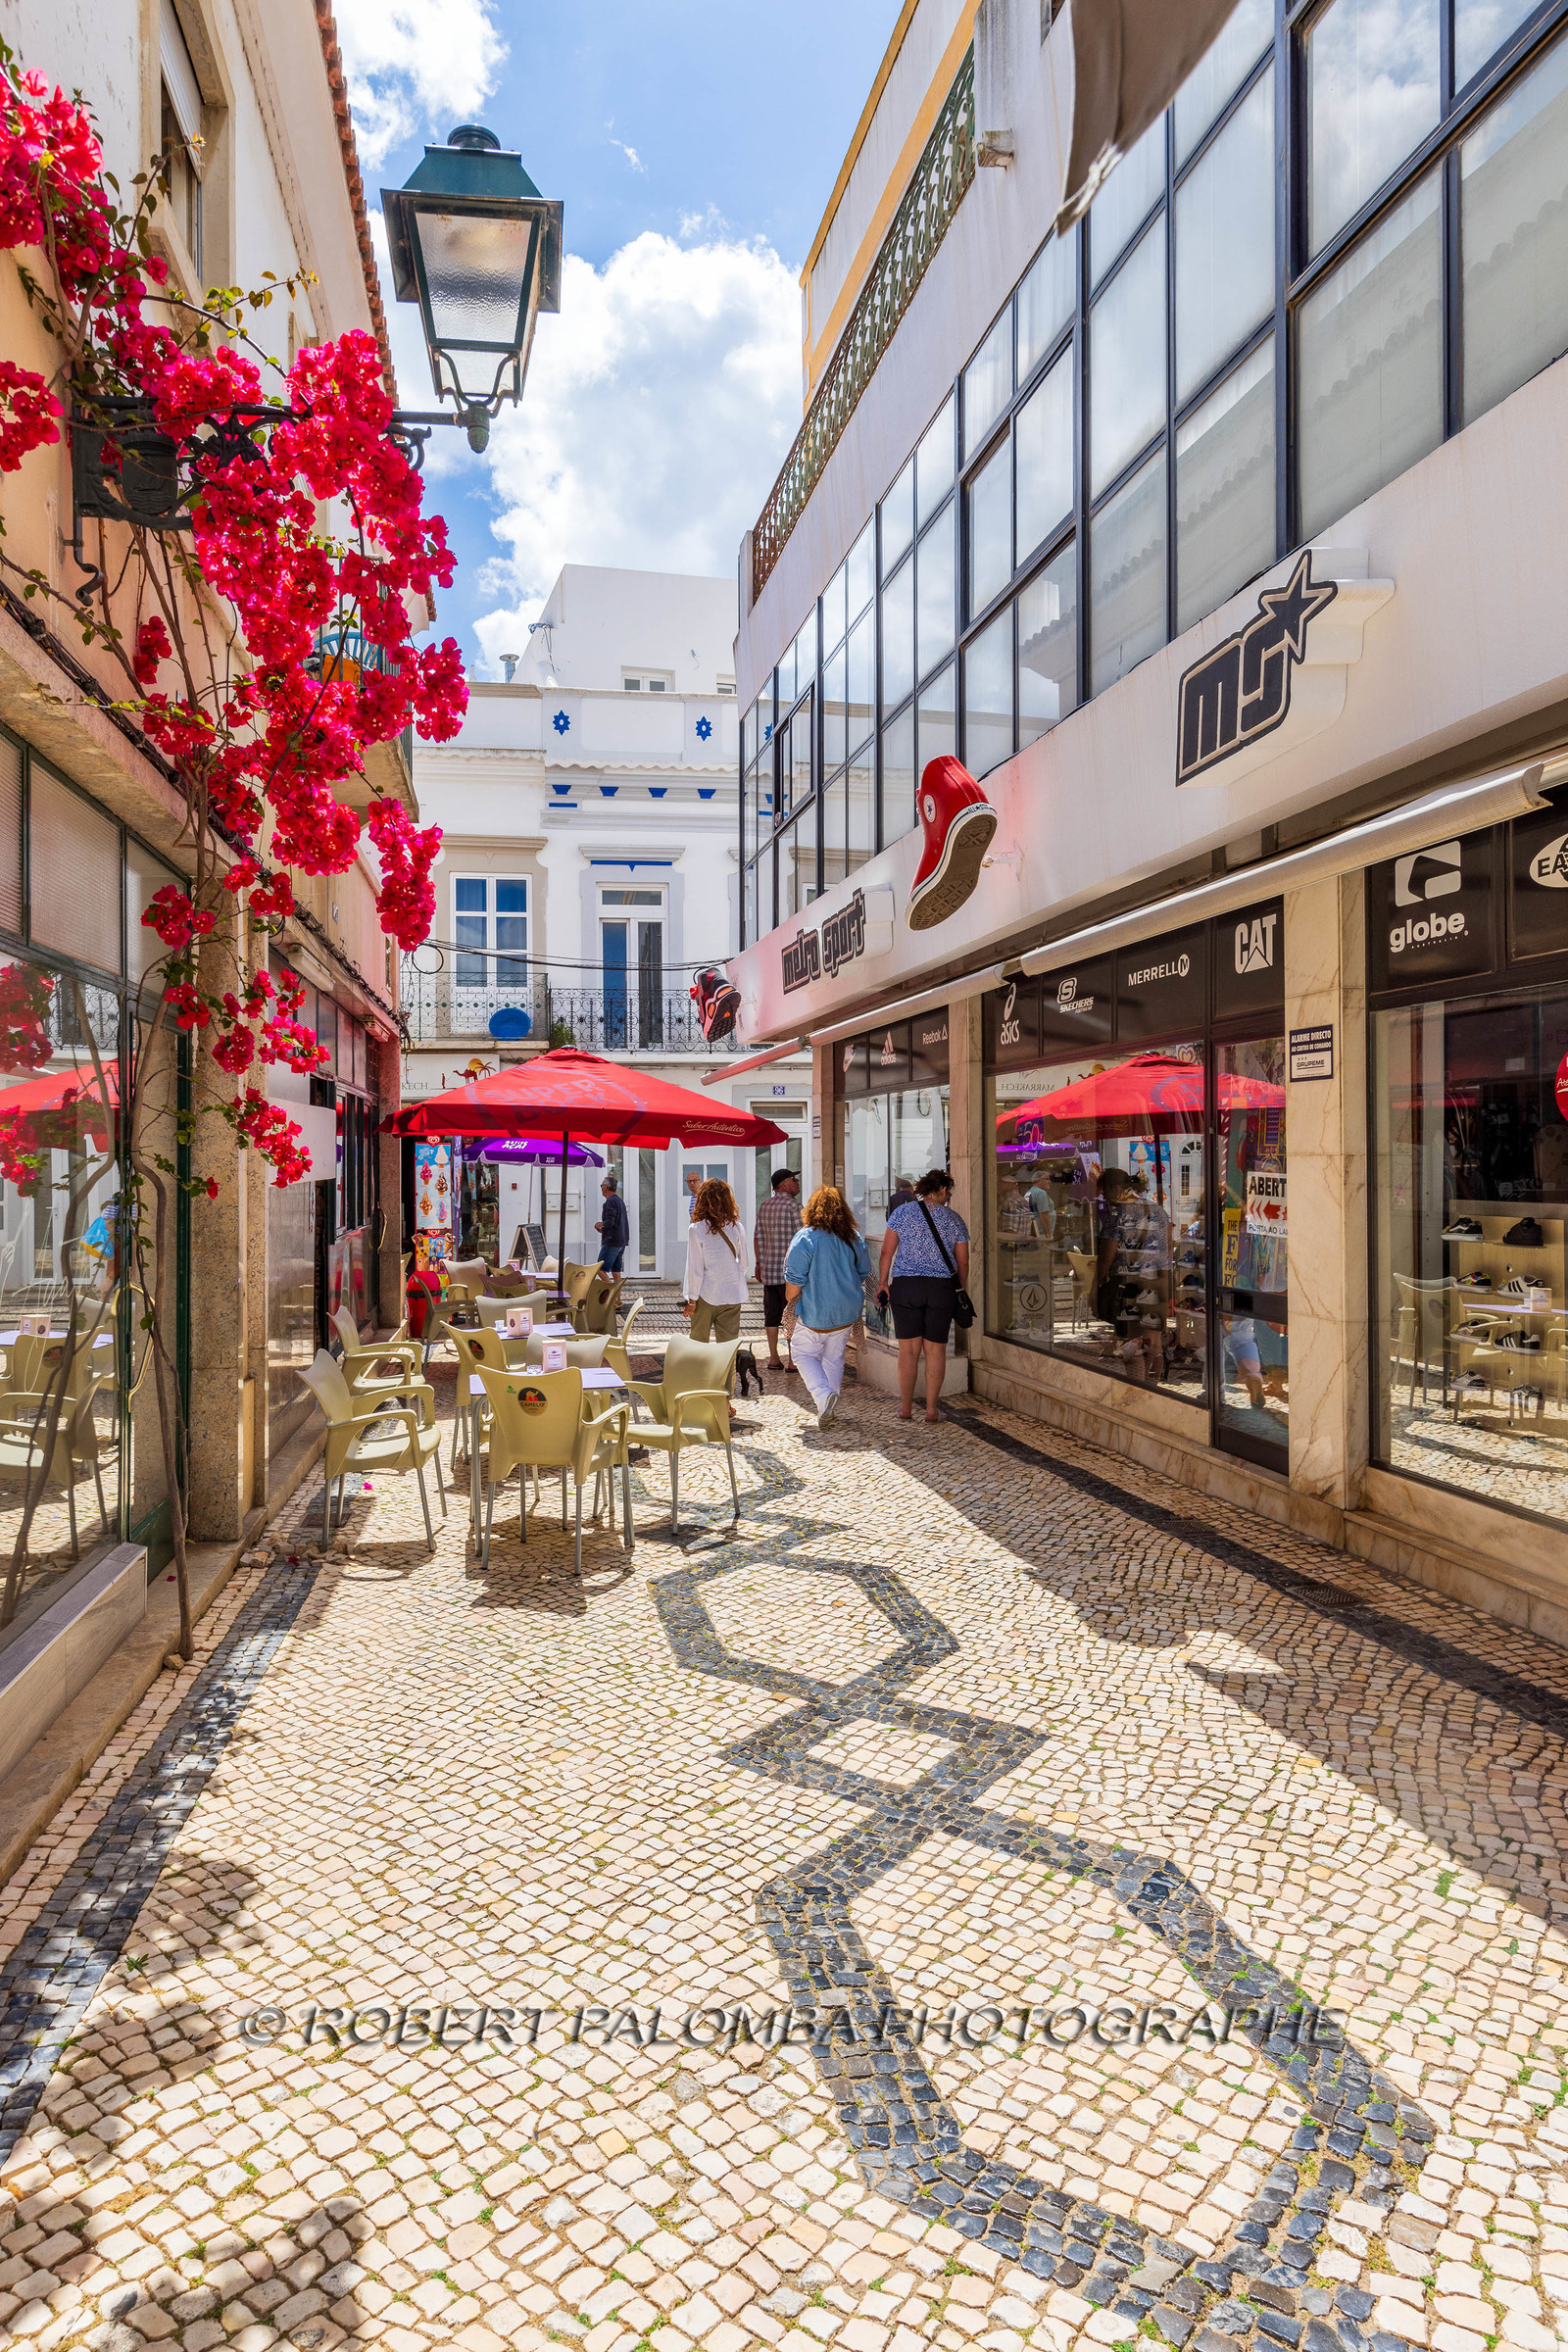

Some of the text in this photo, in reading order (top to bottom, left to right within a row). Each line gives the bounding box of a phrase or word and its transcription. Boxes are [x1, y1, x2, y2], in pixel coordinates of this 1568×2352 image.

[1390, 912, 1465, 953] globe
[781, 887, 866, 995] metro sport
[1235, 913, 1277, 974] CAT
[1128, 961, 1178, 987] MERRELL
[1059, 997, 1095, 1013] SKECHERS
[922, 1029, 942, 1045] Reebok
[1000, 1019, 1020, 1046] asics
[1291, 1030, 1332, 1044] ALARME DIRECTO
[880, 1053, 897, 1066] adidas
[484, 1080, 605, 1103] SUPER
[773, 1086, 784, 1096] 96
[682, 1120, 708, 1129] Sabor
[1228, 1220, 1238, 1232] THE
[1249, 1223, 1267, 1234] PORTA
